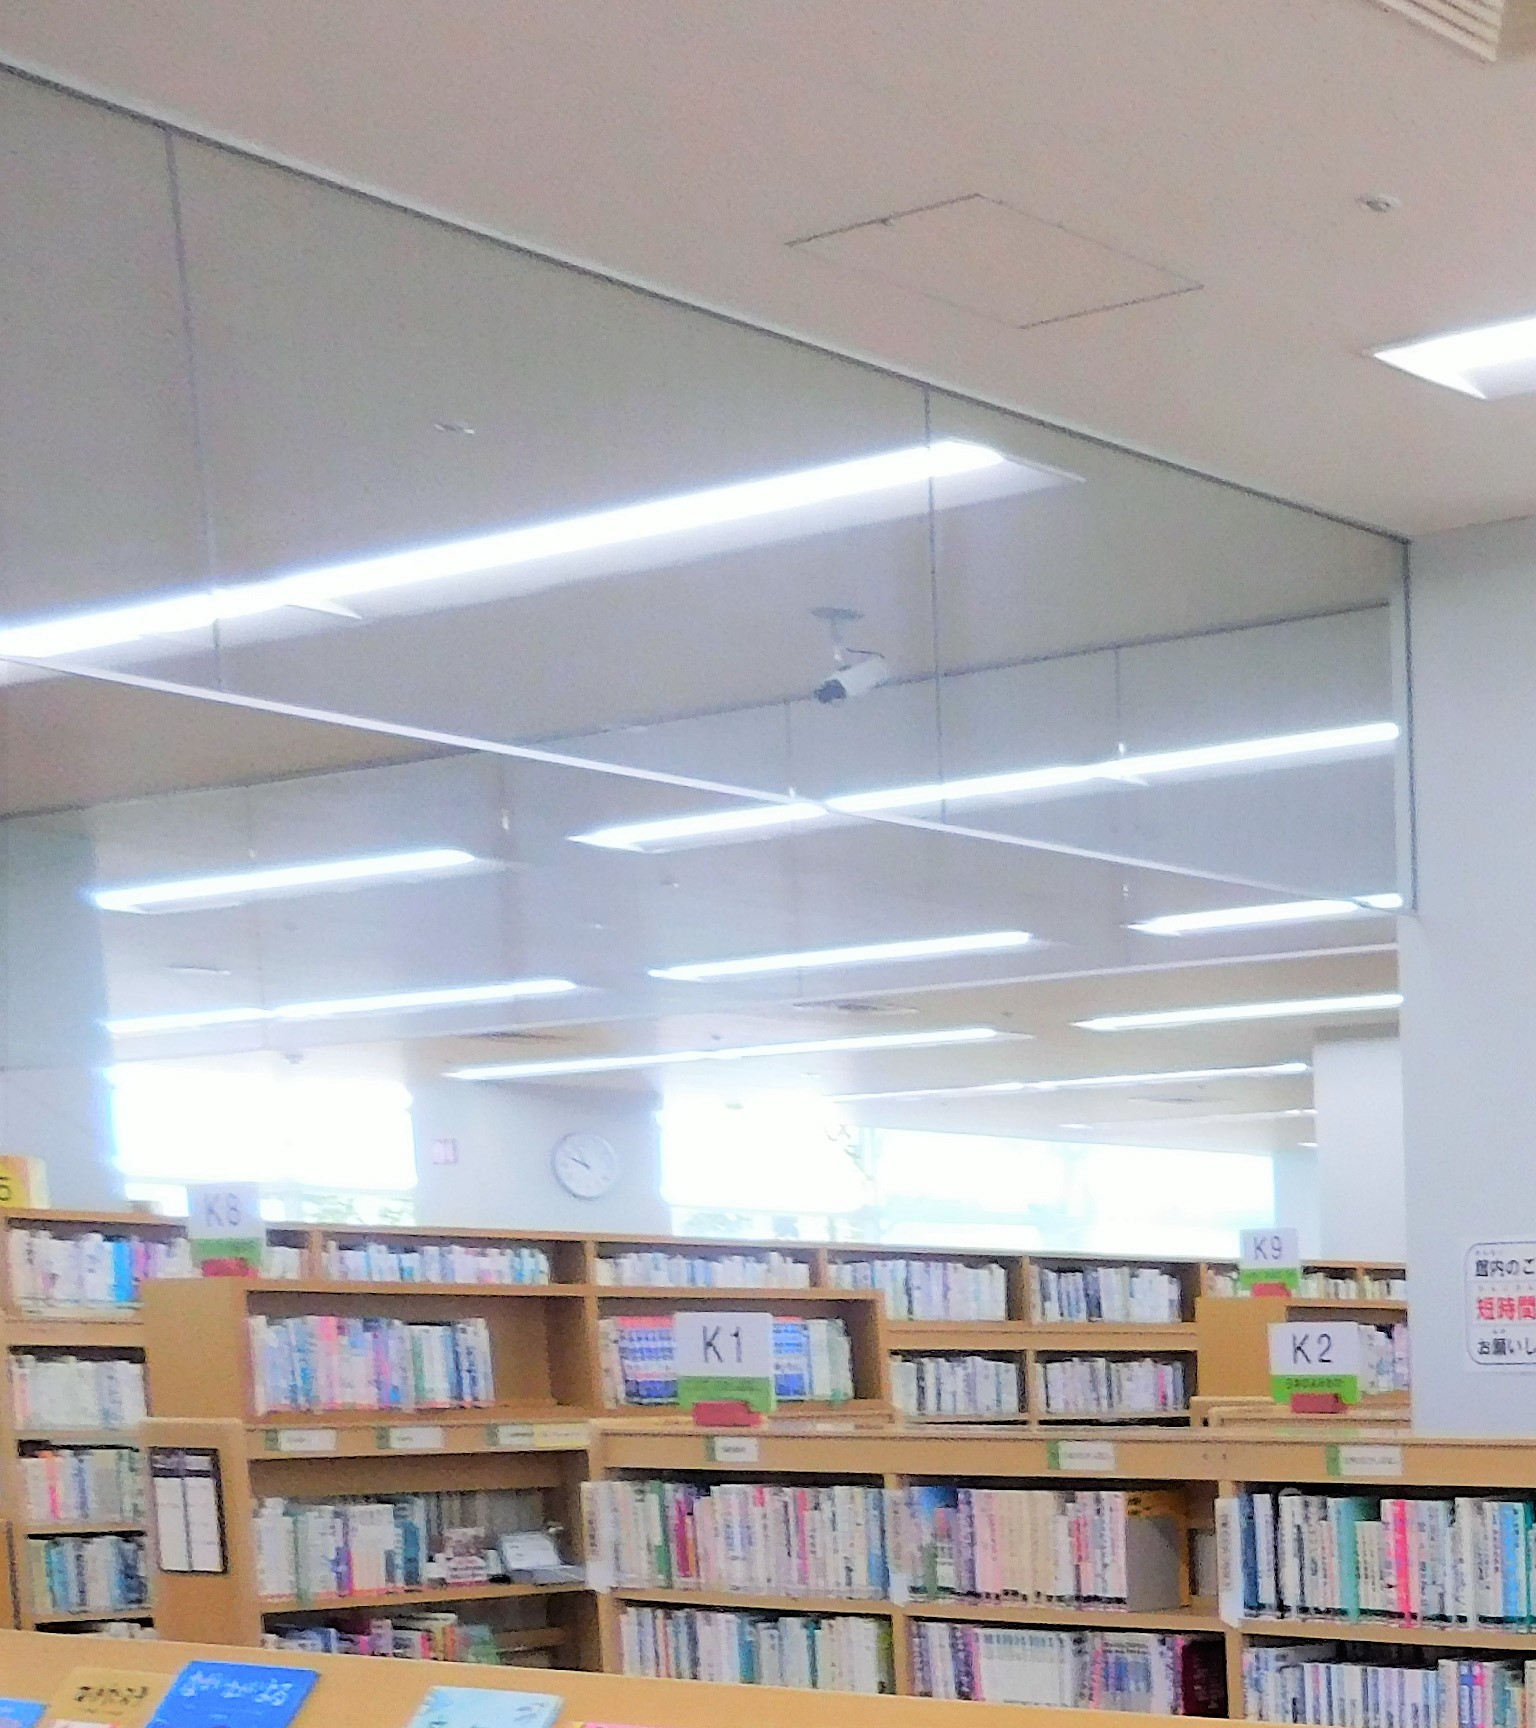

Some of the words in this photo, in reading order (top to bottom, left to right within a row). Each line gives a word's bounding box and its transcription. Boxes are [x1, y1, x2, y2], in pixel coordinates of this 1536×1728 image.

[1253, 1236, 1283, 1260] K9
[702, 1325, 743, 1363] K1
[1292, 1333, 1333, 1365] K2
